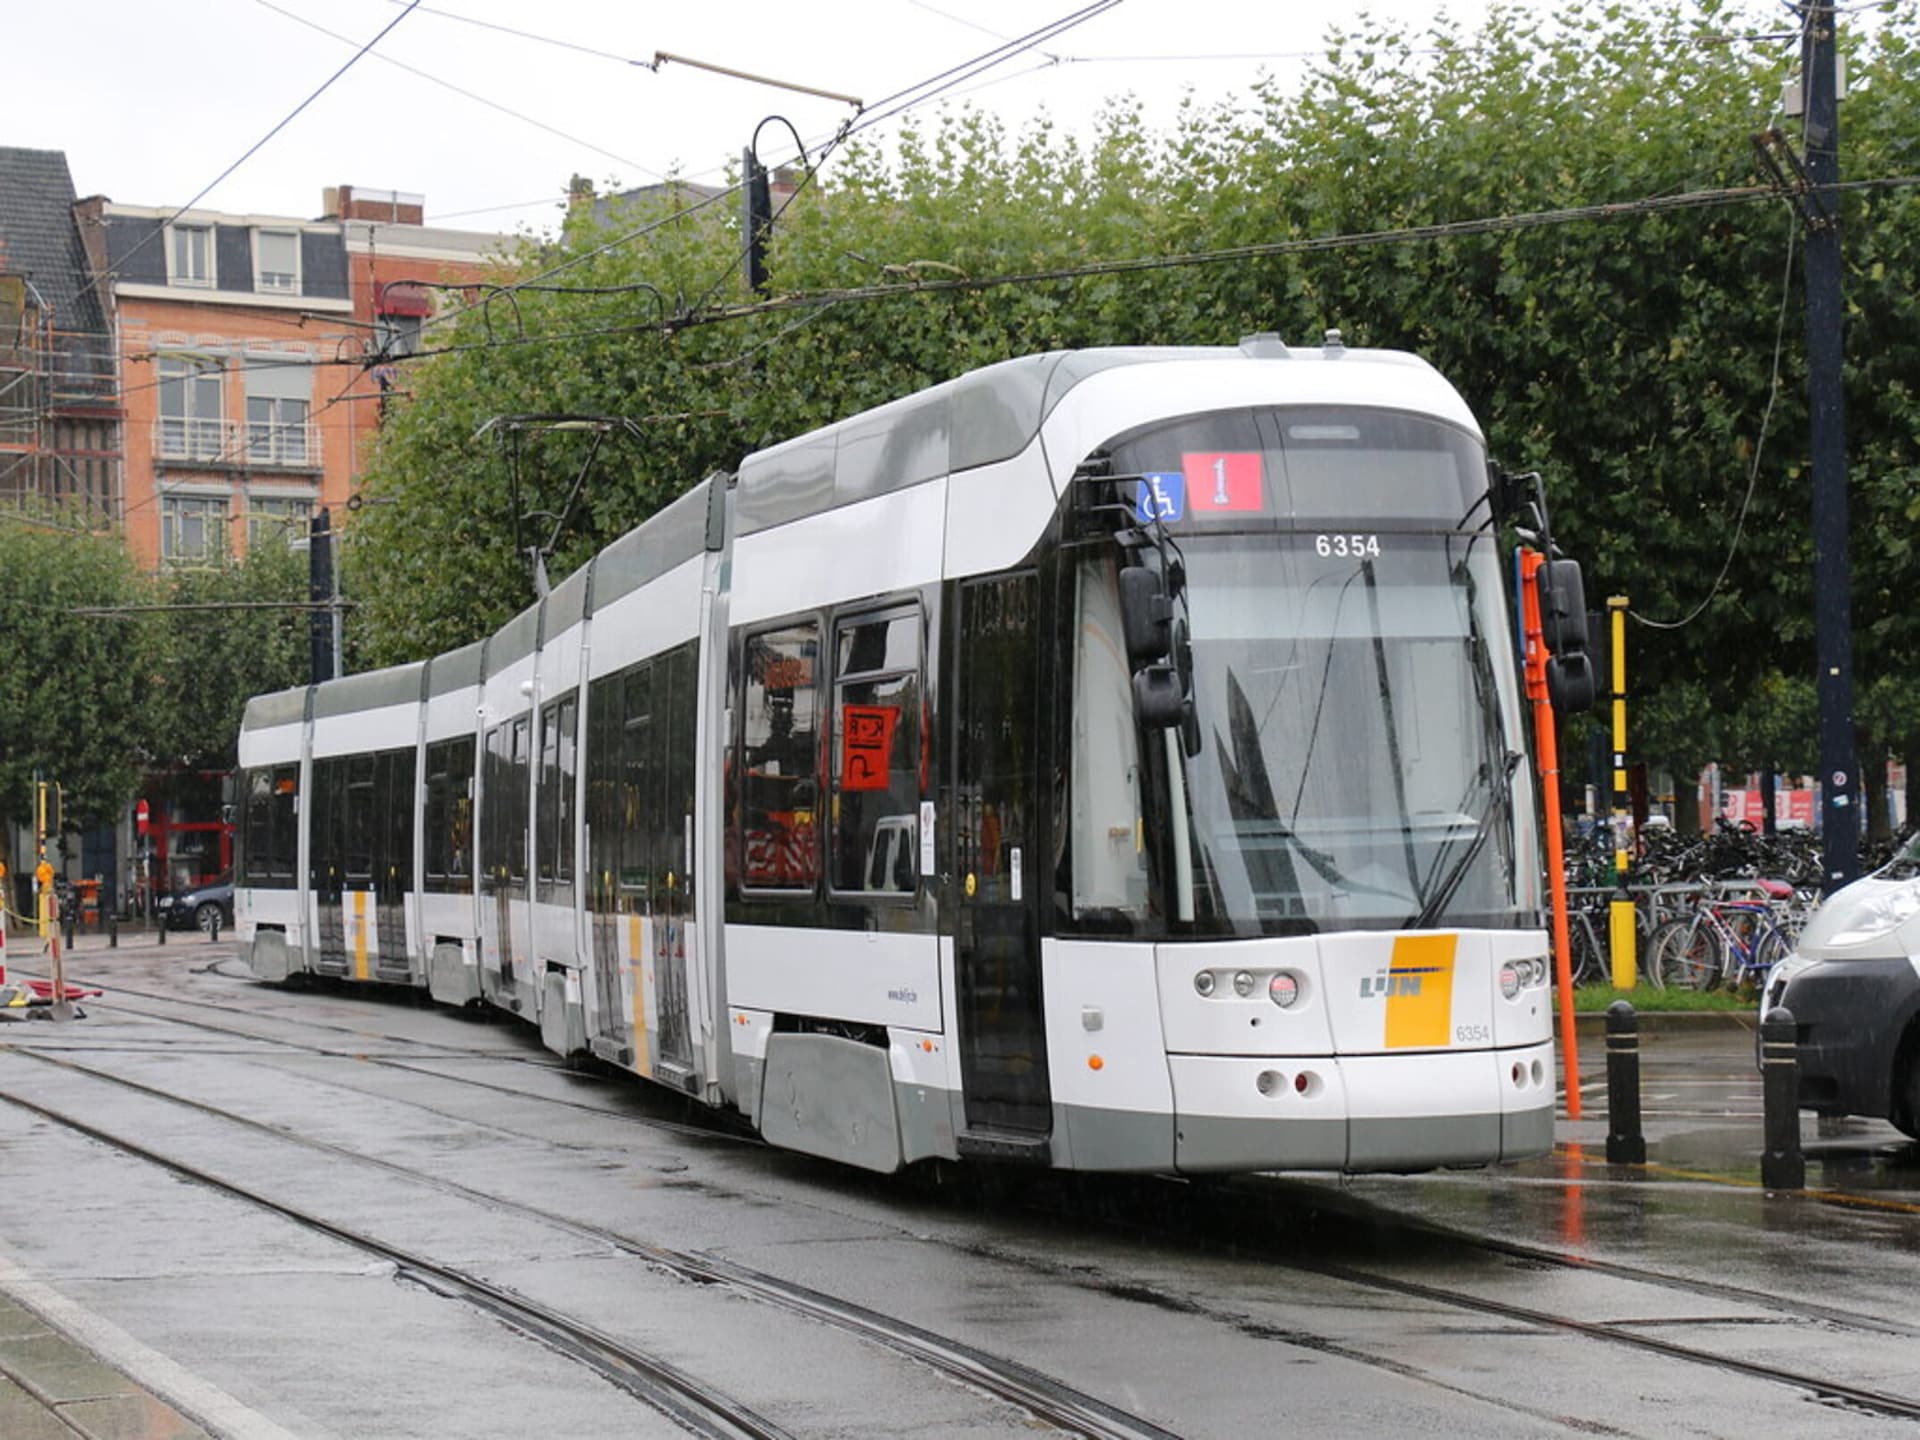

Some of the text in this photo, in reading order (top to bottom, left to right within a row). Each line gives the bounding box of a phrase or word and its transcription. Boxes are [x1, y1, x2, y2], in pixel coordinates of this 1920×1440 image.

[1212, 458, 1229, 504] 1
[1315, 534, 1381, 557] 6354
[1456, 1025, 1489, 1042] 6354
